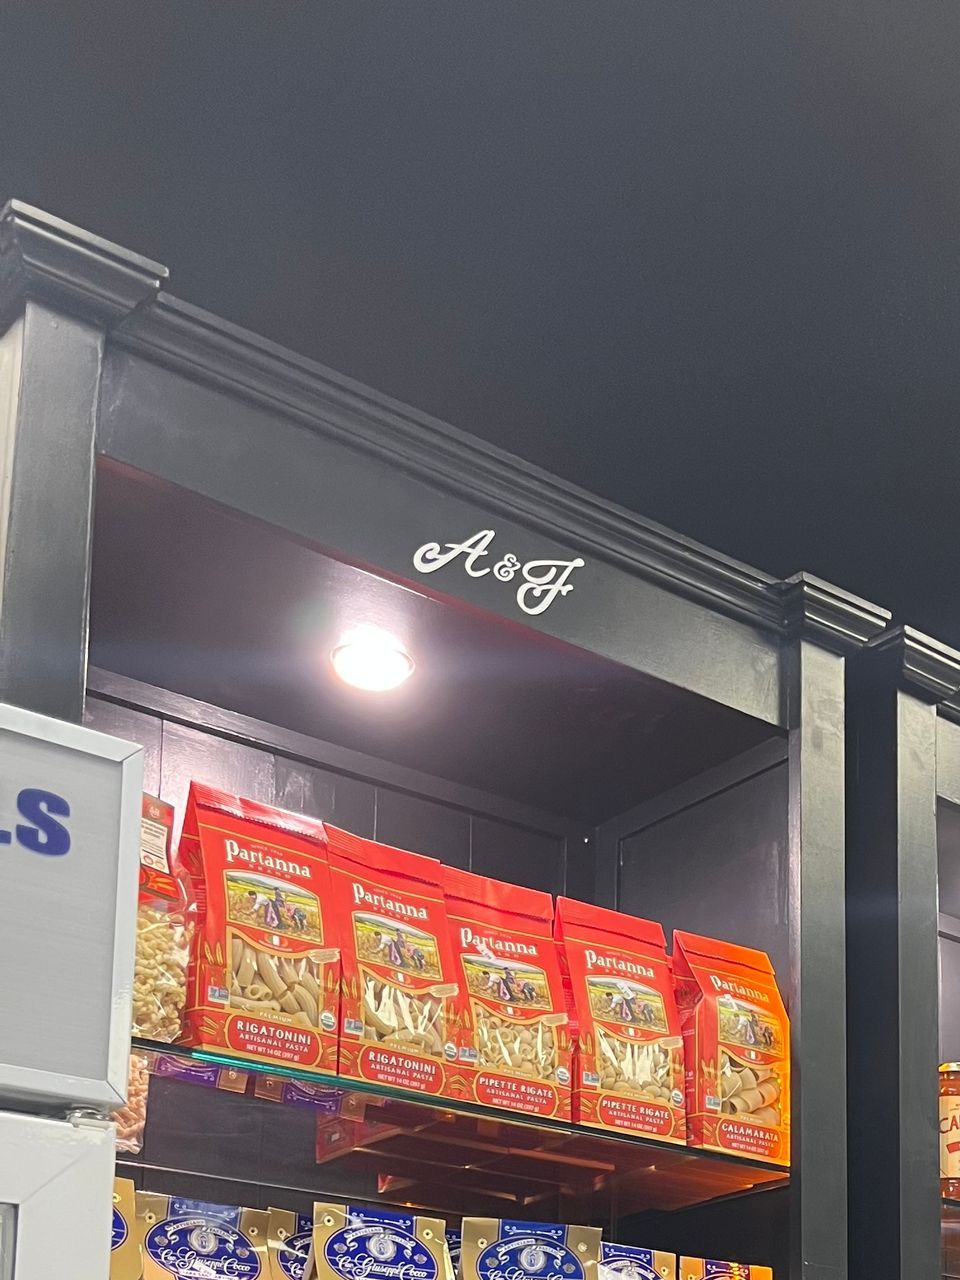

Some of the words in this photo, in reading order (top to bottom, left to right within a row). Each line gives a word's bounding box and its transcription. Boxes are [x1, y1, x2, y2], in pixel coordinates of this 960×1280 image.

[224, 839, 313, 878] Partanna
[352, 882, 428, 920] Partanna
[460, 927, 538, 956] Partanna
[584, 949, 655, 979] Partanna
[709, 975, 769, 1003] Partanna
[236, 1020, 311, 1046] RIGATONINI
[239, 1033, 282, 1048] ARTISANAL
[285, 1041, 309, 1054] PASTA
[368, 1051, 437, 1075] RIGATONINI
[371, 1063, 411, 1078] ARTISANAL
[412, 1072, 434, 1083] PASTA
[479, 1077, 519, 1092] PIPETTE
[520, 1084, 554, 1099] RIGATE
[486, 1088, 524, 1102] ARTISANAL
[526, 1096, 548, 1106] PASTA
[602, 1099, 638, 1115] PIPETTE
[639, 1107, 671, 1120] RIGATE
[608, 1110, 643, 1124] ARTISANAL
[645, 1116, 665, 1126] PASTA
[721, 1123, 779, 1143] CALAMARATA
